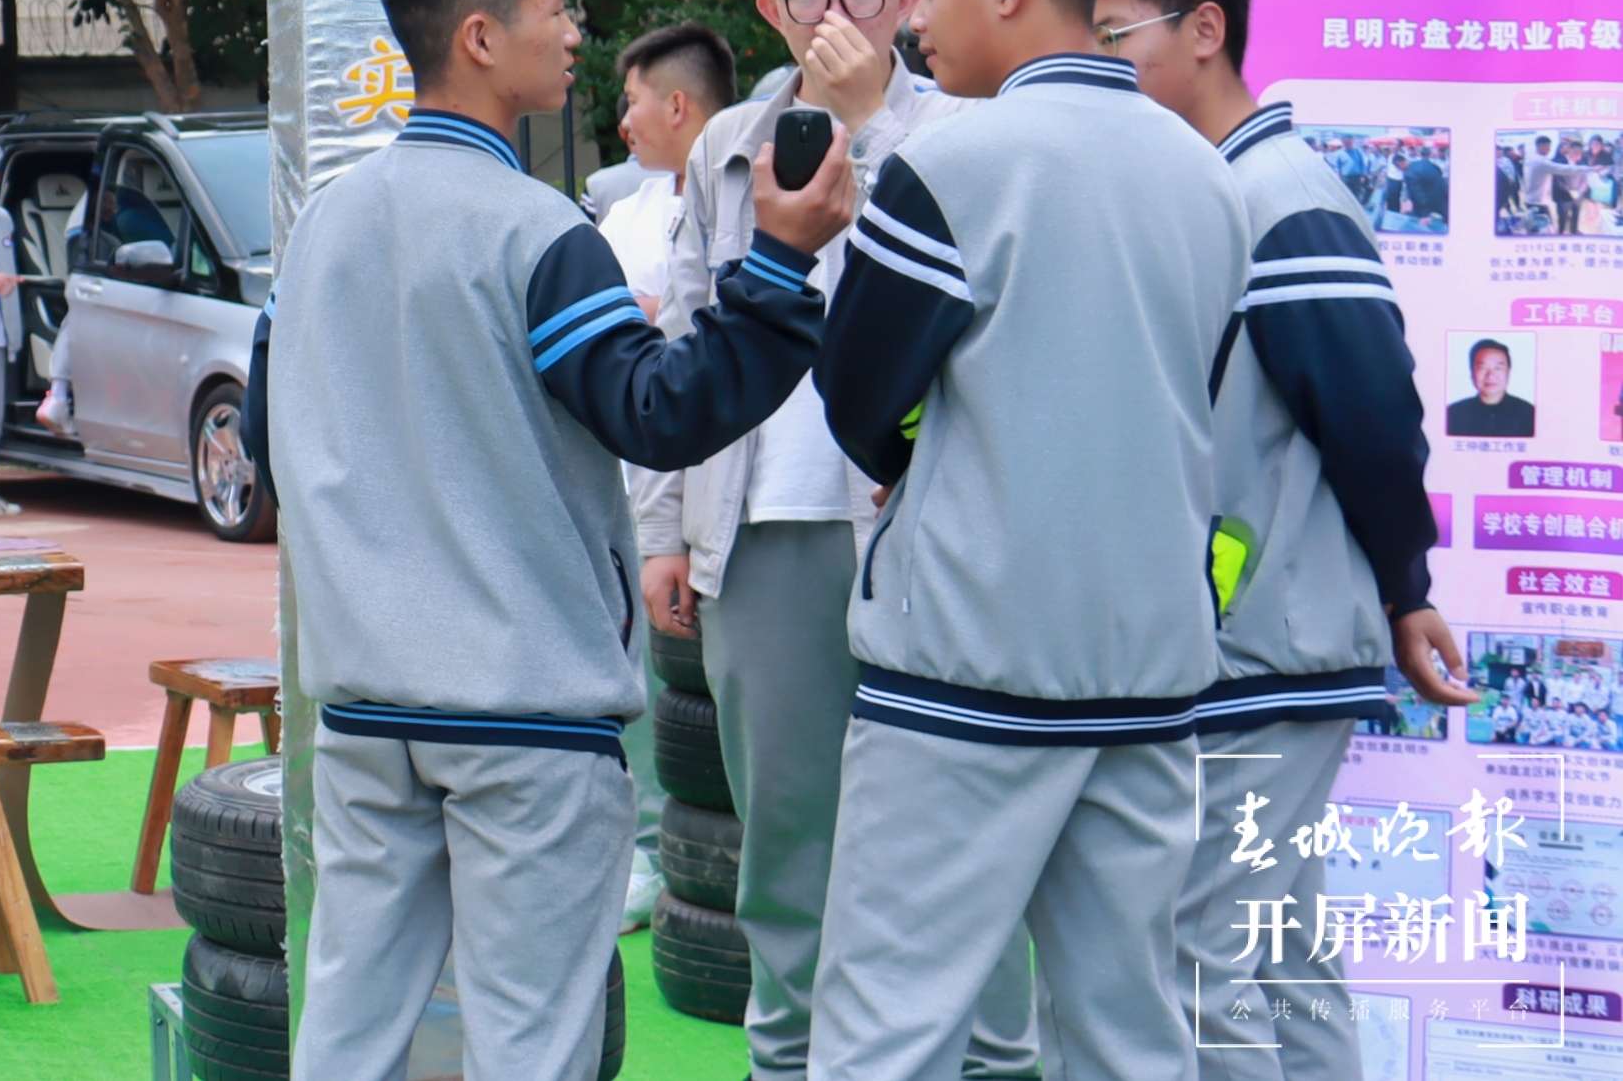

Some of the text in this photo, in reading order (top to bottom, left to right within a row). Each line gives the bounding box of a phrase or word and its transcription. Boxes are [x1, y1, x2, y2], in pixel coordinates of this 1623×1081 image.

[1322, 19, 1623, 51] 昆明市盘龙职业高级
[1523, 304, 1614, 325] 工作平台
[1520, 465, 1613, 489] 管理机制
[1518, 571, 1611, 597] 社会效益
[1515, 987, 1608, 1017] 科研成果
